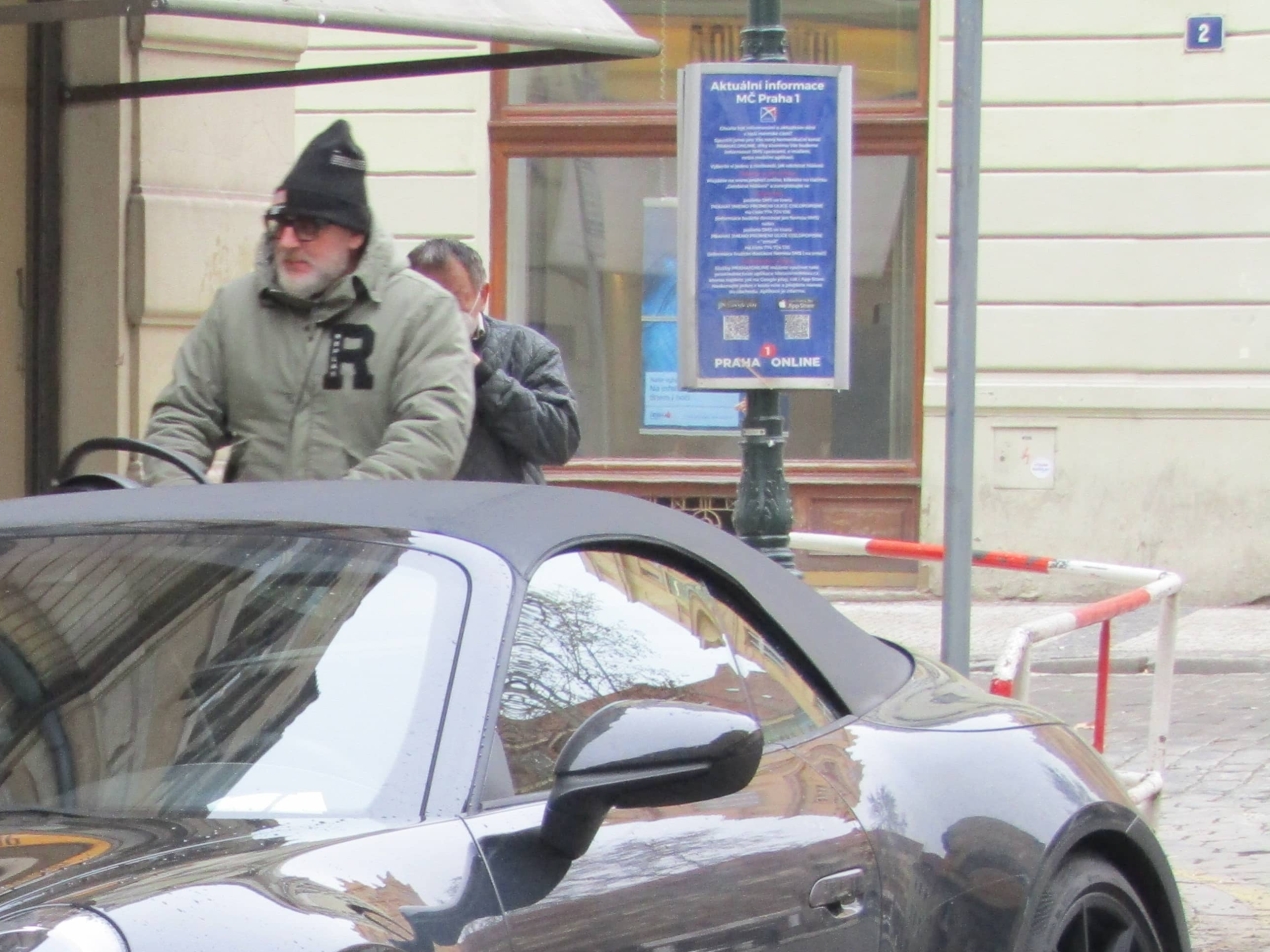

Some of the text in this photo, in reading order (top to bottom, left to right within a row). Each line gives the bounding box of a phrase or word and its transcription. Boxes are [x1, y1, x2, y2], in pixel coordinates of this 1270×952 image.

[1197, 23, 1210, 43] 2
[710, 80, 825, 91] Aktuální informace
[736, 91, 801, 104] MČ Praha 1
[323, 323, 376, 390] R
[764, 346, 771, 356] 1
[714, 357, 821, 368] PRAHA ONLINE
